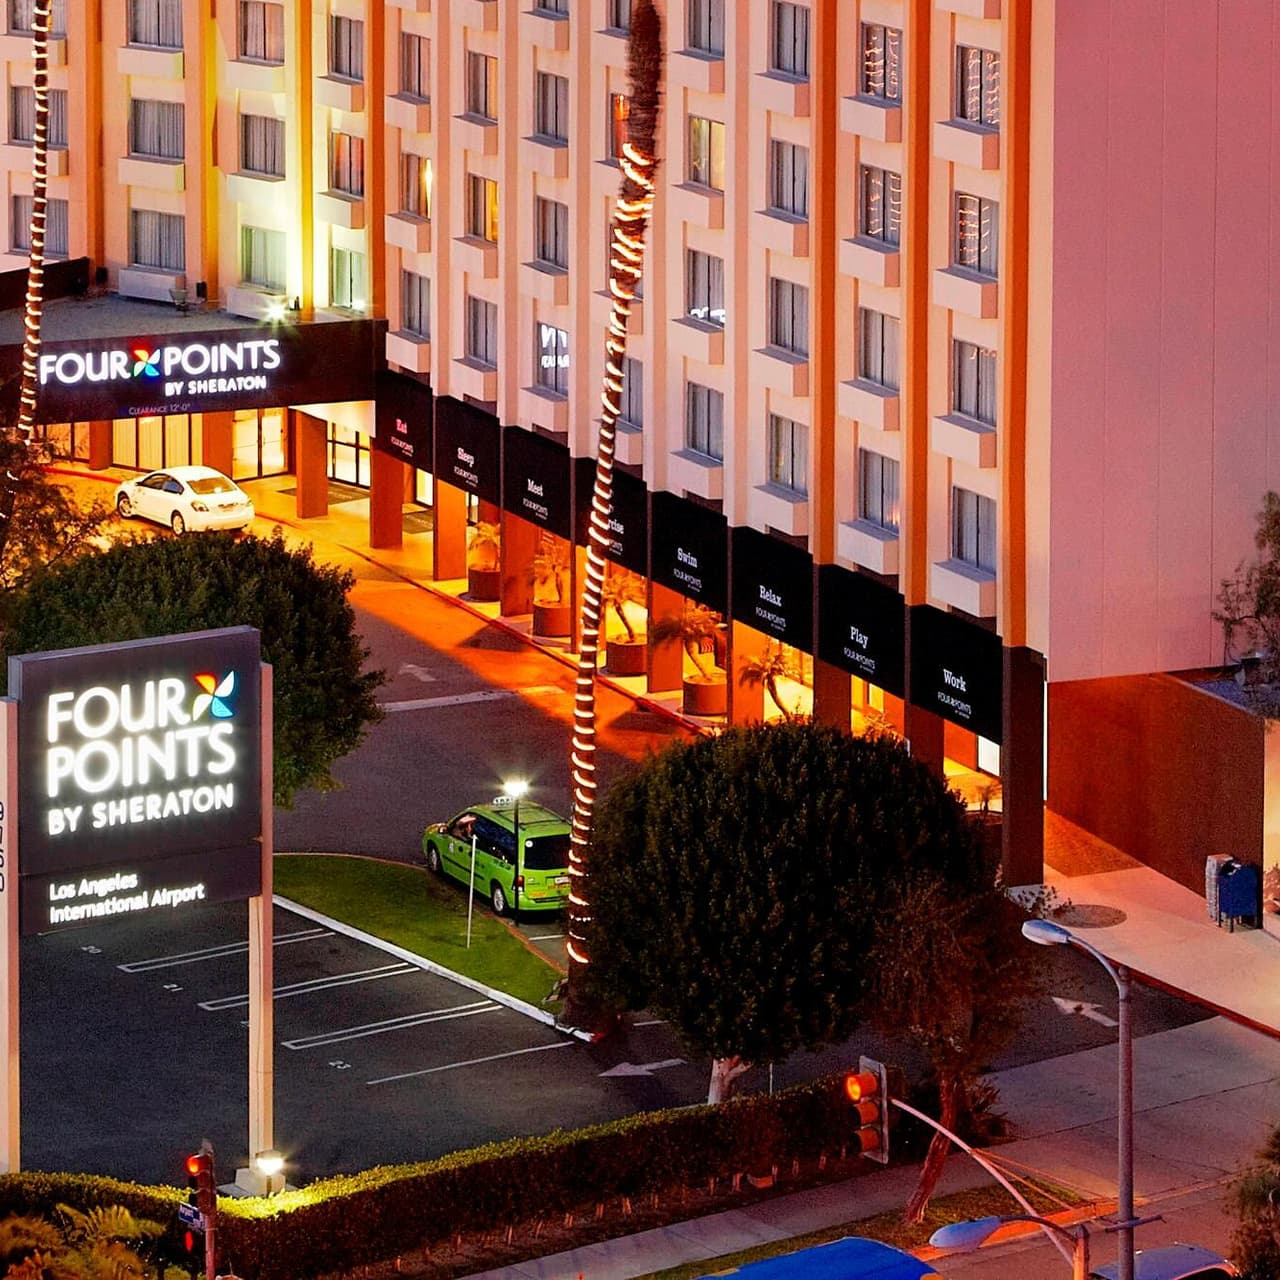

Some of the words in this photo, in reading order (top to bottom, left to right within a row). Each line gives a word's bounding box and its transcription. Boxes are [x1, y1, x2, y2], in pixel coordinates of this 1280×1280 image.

[40, 351, 131, 385] FOUR
[164, 339, 280, 376] POINTS
[165, 381, 184, 397] BY
[188, 375, 266, 395] SHERATON
[129, 405, 167, 416] CLEARANCE
[457, 447, 474, 467] Sleep
[528, 478, 543, 496] Meet
[677, 547, 697, 568] Swim
[760, 585, 782, 607] Relax
[850, 625, 868, 649] Play
[943, 669, 966, 692] Work
[48, 677, 192, 743] FOUR
[47, 723, 237, 798] POINTS
[48, 805, 83, 836] BY
[93, 783, 234, 829] SHERATON
[50, 882, 76, 901] Los
[78, 872, 138, 898] Angeles
[50, 894, 149, 924] International
[151, 883, 206, 909] Airport
